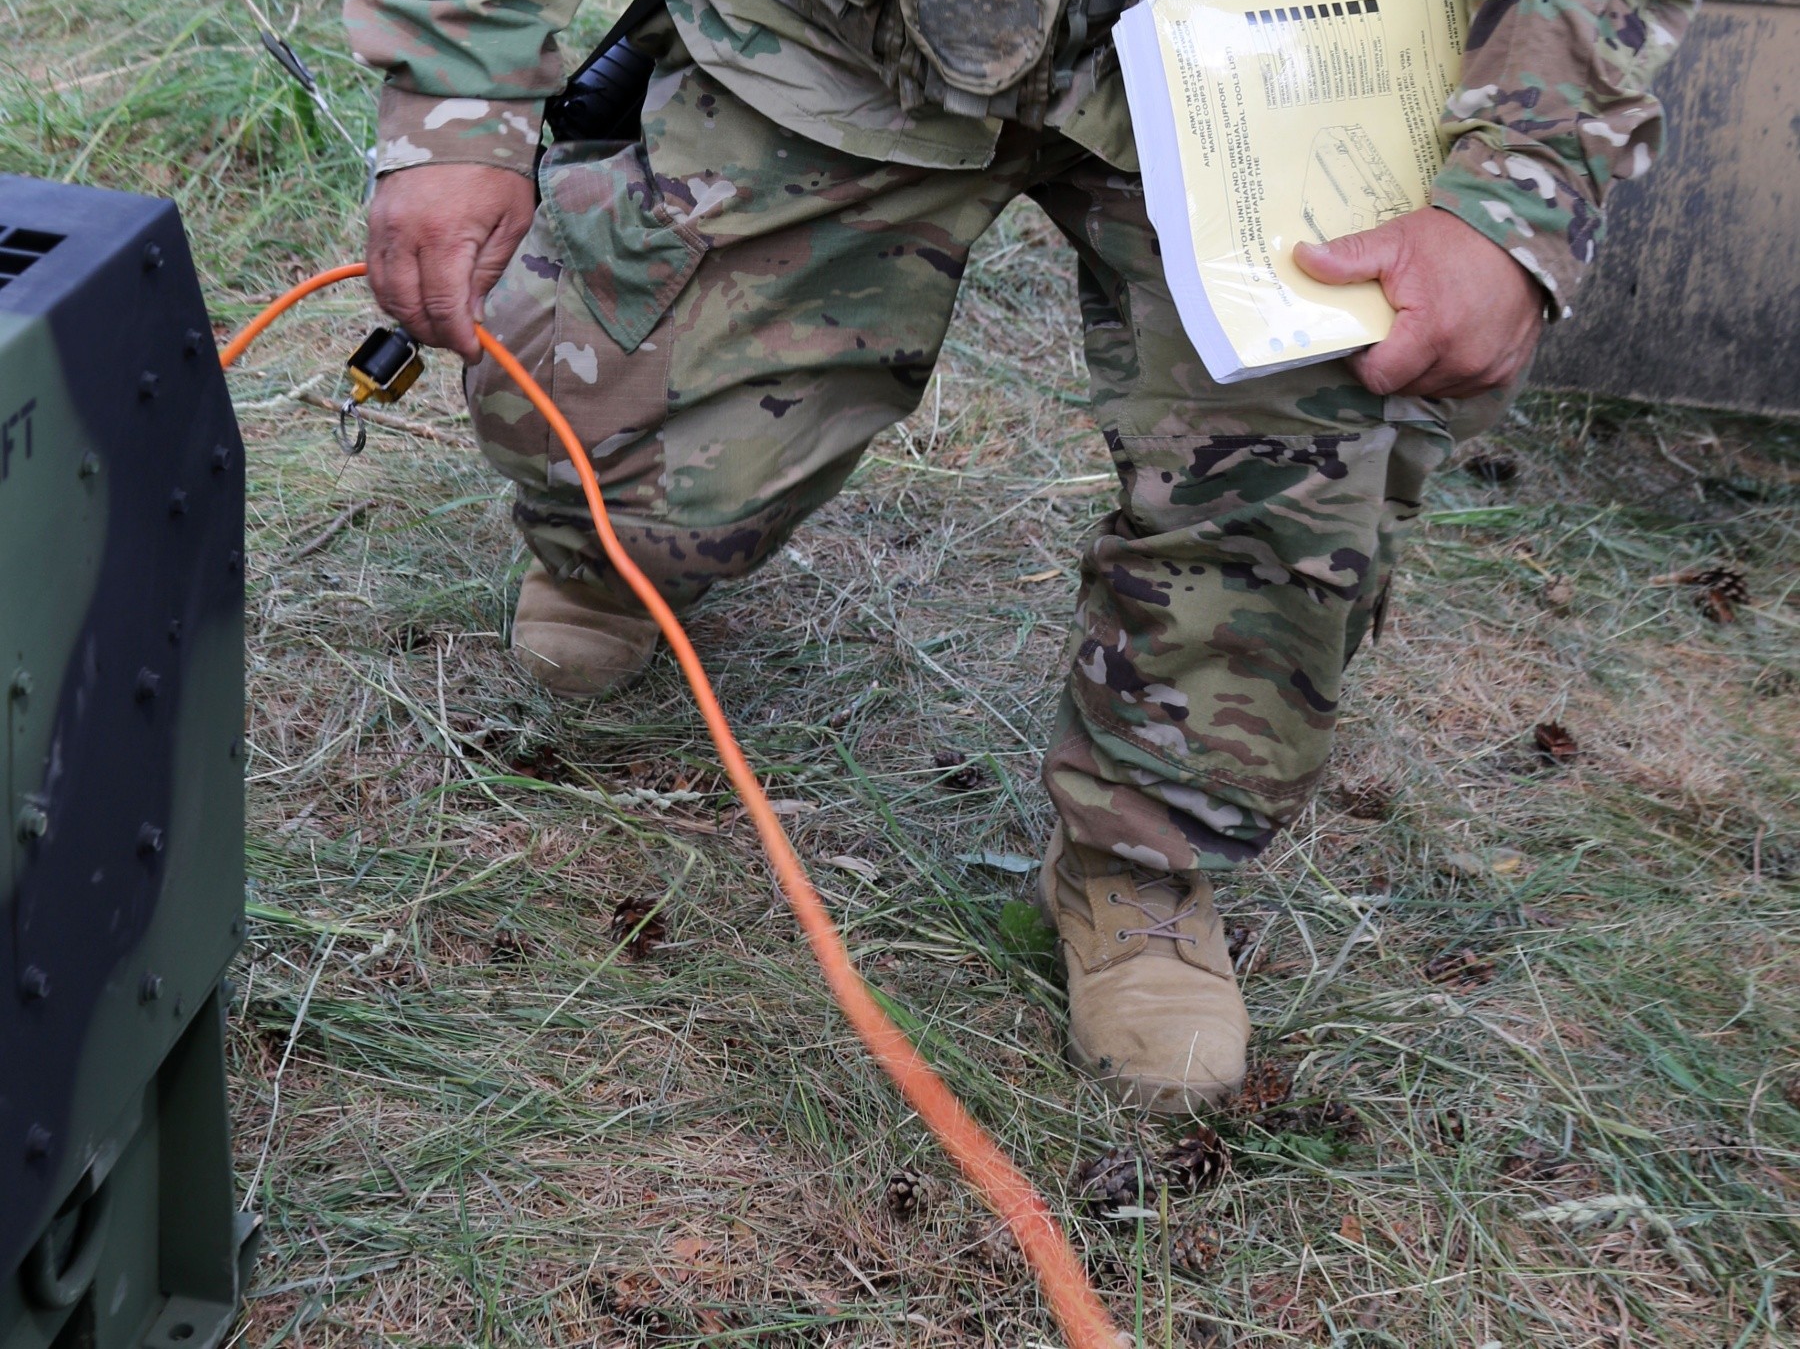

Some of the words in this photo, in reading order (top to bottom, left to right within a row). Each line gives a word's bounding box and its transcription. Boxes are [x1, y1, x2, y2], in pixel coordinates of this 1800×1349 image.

[1195, 69, 1203, 82] TM
[1231, 72, 1243, 106] TOOLS
[1395, 75, 1404, 92] SET
[1185, 94, 1193, 107] TM
[1194, 104, 1202, 117] TO
[1198, 84, 1209, 116] CORPS
[1216, 80, 1231, 129] SUPPORT
[1188, 109, 1198, 135] ARMY
[1197, 118, 1208, 149] FORCE
[1204, 117, 1215, 152] MARINE
[1238, 108, 1250, 152] SPECIAL
[1398, 93, 1417, 145] GENERATOR
[1225, 130, 1237, 168] DIRECT
[1232, 120, 1244, 165] MANUAL
[1202, 152, 1210, 167] AIR
[1245, 154, 1254, 177] AND
[1252, 156, 1262, 176] THE
[1413, 147, 1424, 173] QUIET
[1231, 170, 1241, 194] AND
[1248, 179, 1259, 214] PARTS
[1255, 179, 1265, 201] FOR
[1235, 195, 1245, 223] UNIT,
[1238, 166, 1256, 241] MAINTENANCE
[1254, 215, 1267, 253] REPAIR
[1239, 224, 1260, 282] OERATOR,
